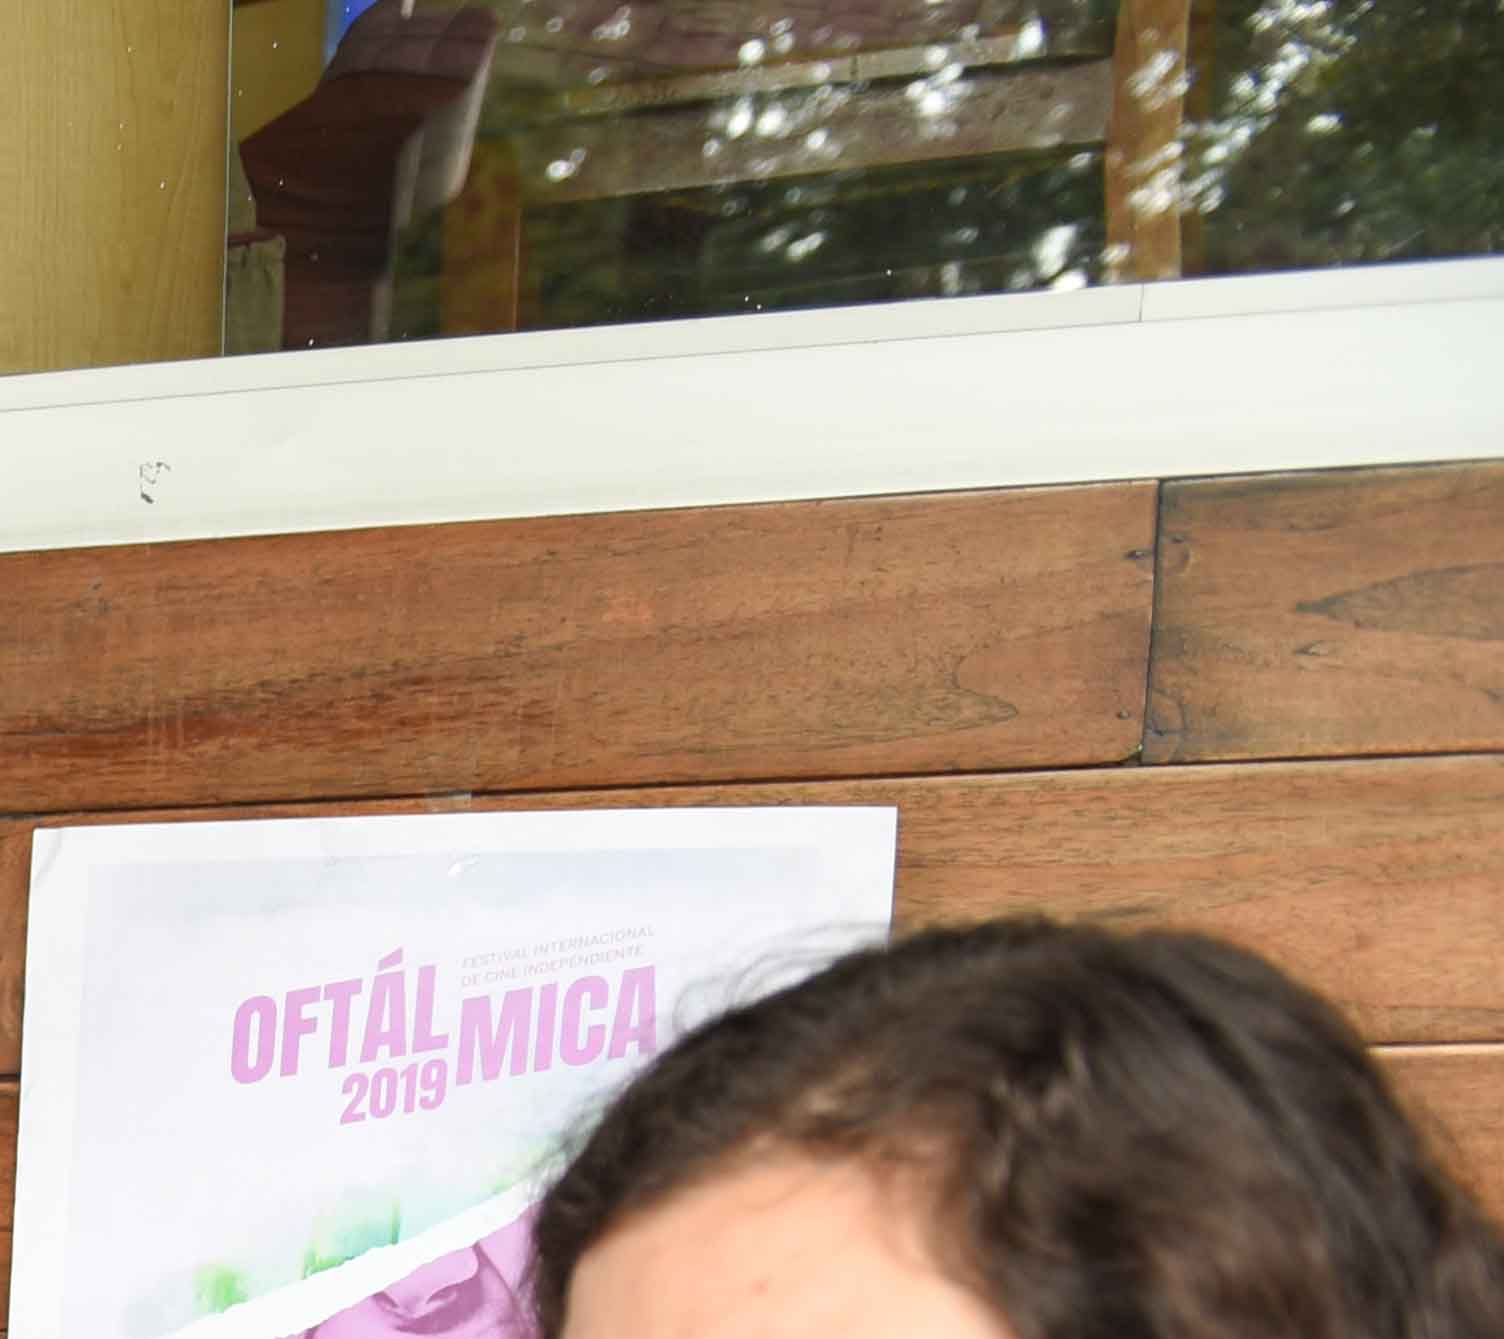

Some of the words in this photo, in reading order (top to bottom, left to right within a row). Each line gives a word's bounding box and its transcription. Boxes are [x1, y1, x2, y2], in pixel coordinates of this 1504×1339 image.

[461, 945, 531, 969] FESTIVAL
[533, 924, 657, 955] INTERNACIONAL
[484, 965, 521, 983] CINE
[231, 946, 448, 1084] OFTÁL
[455, 964, 657, 1087] MICA
[339, 1057, 448, 1125] 2019
